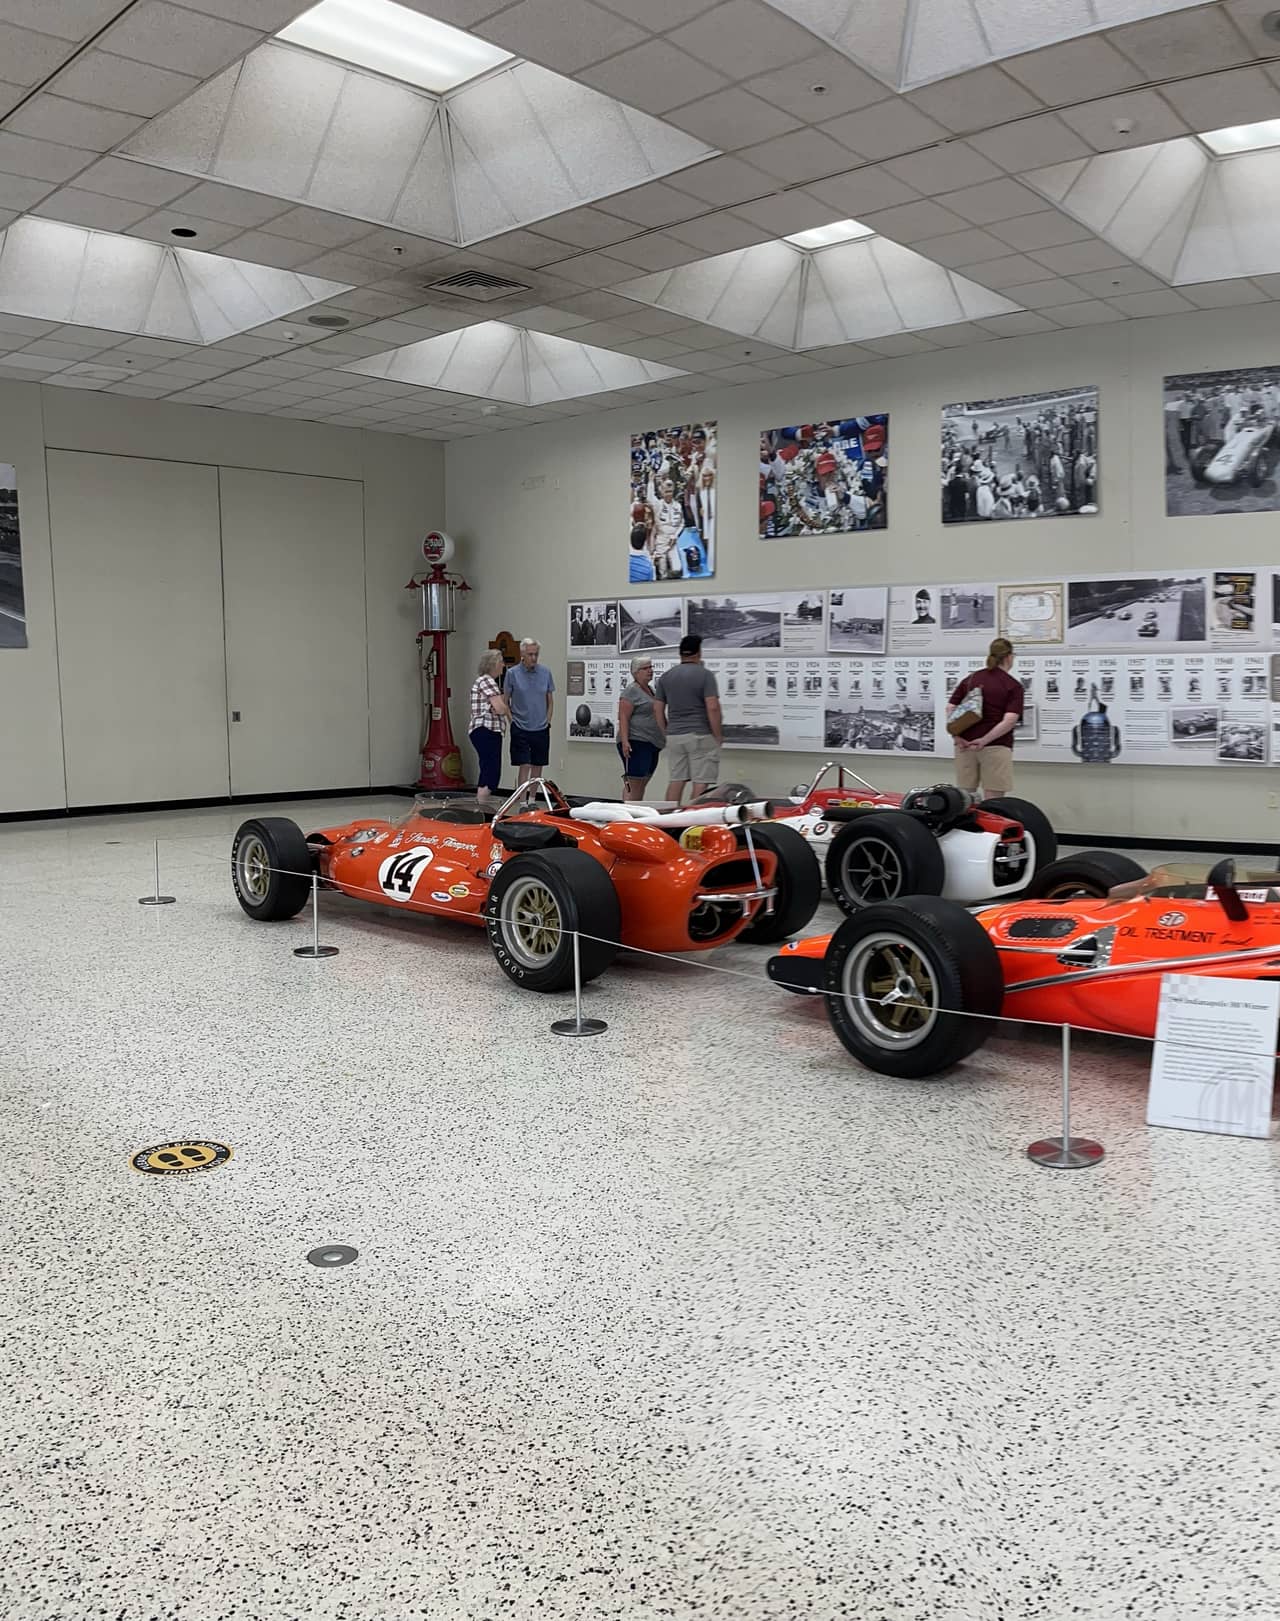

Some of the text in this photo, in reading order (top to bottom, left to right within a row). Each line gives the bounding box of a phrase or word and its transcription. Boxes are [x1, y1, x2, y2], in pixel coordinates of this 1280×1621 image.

[383, 852, 430, 893] 14
[1118, 925, 1139, 939] OIL
[1143, 926, 1217, 944] TREATMENT
[163, 1166, 205, 1175] THANK
